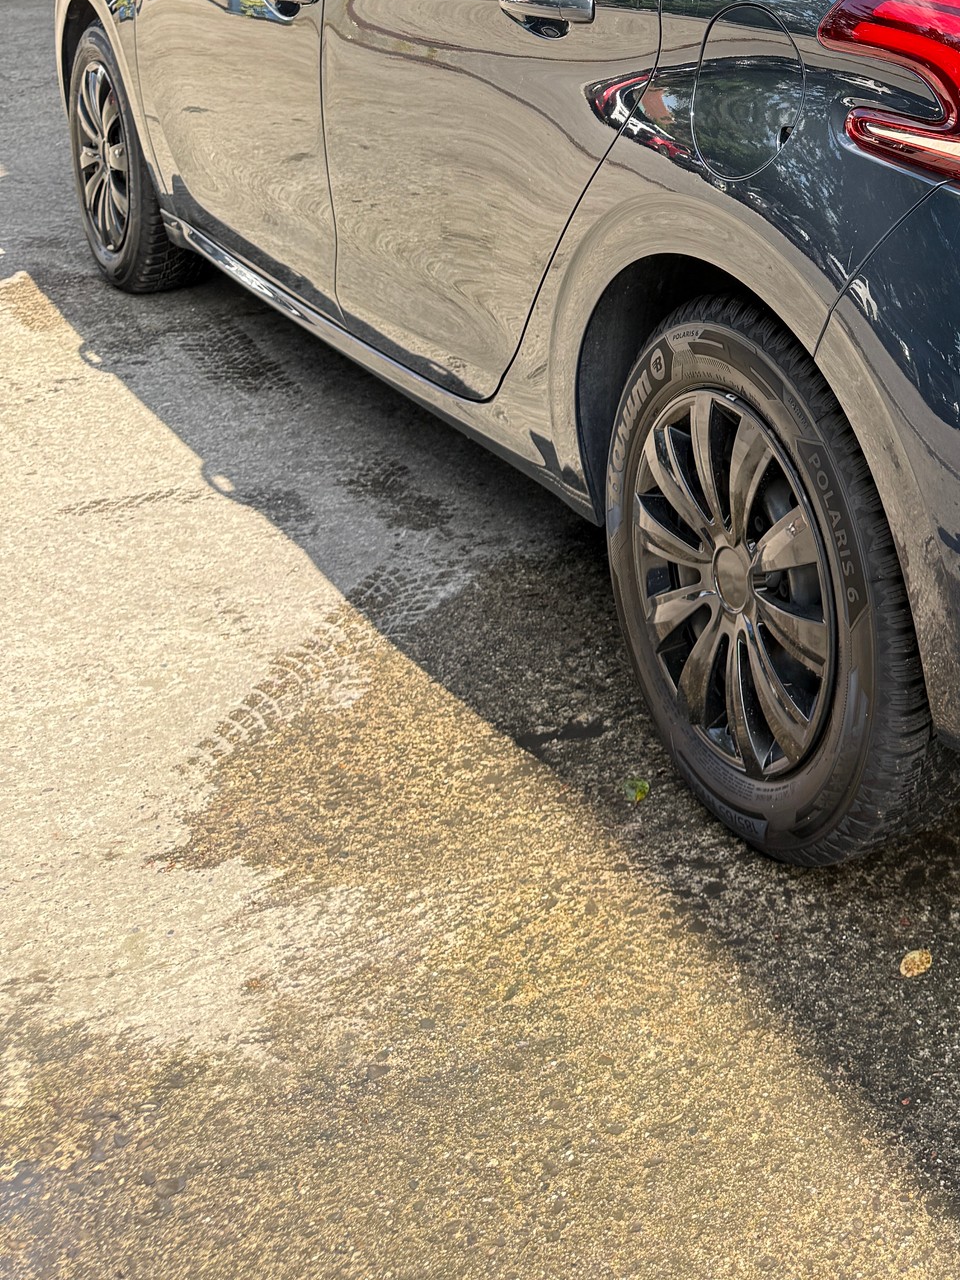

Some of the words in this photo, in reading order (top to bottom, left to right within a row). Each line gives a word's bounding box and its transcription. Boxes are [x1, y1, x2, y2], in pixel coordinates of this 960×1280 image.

[672, 330, 695, 341] POLARIS
[808, 452, 855, 577] POLARIS
[846, 586, 860, 603] 6
